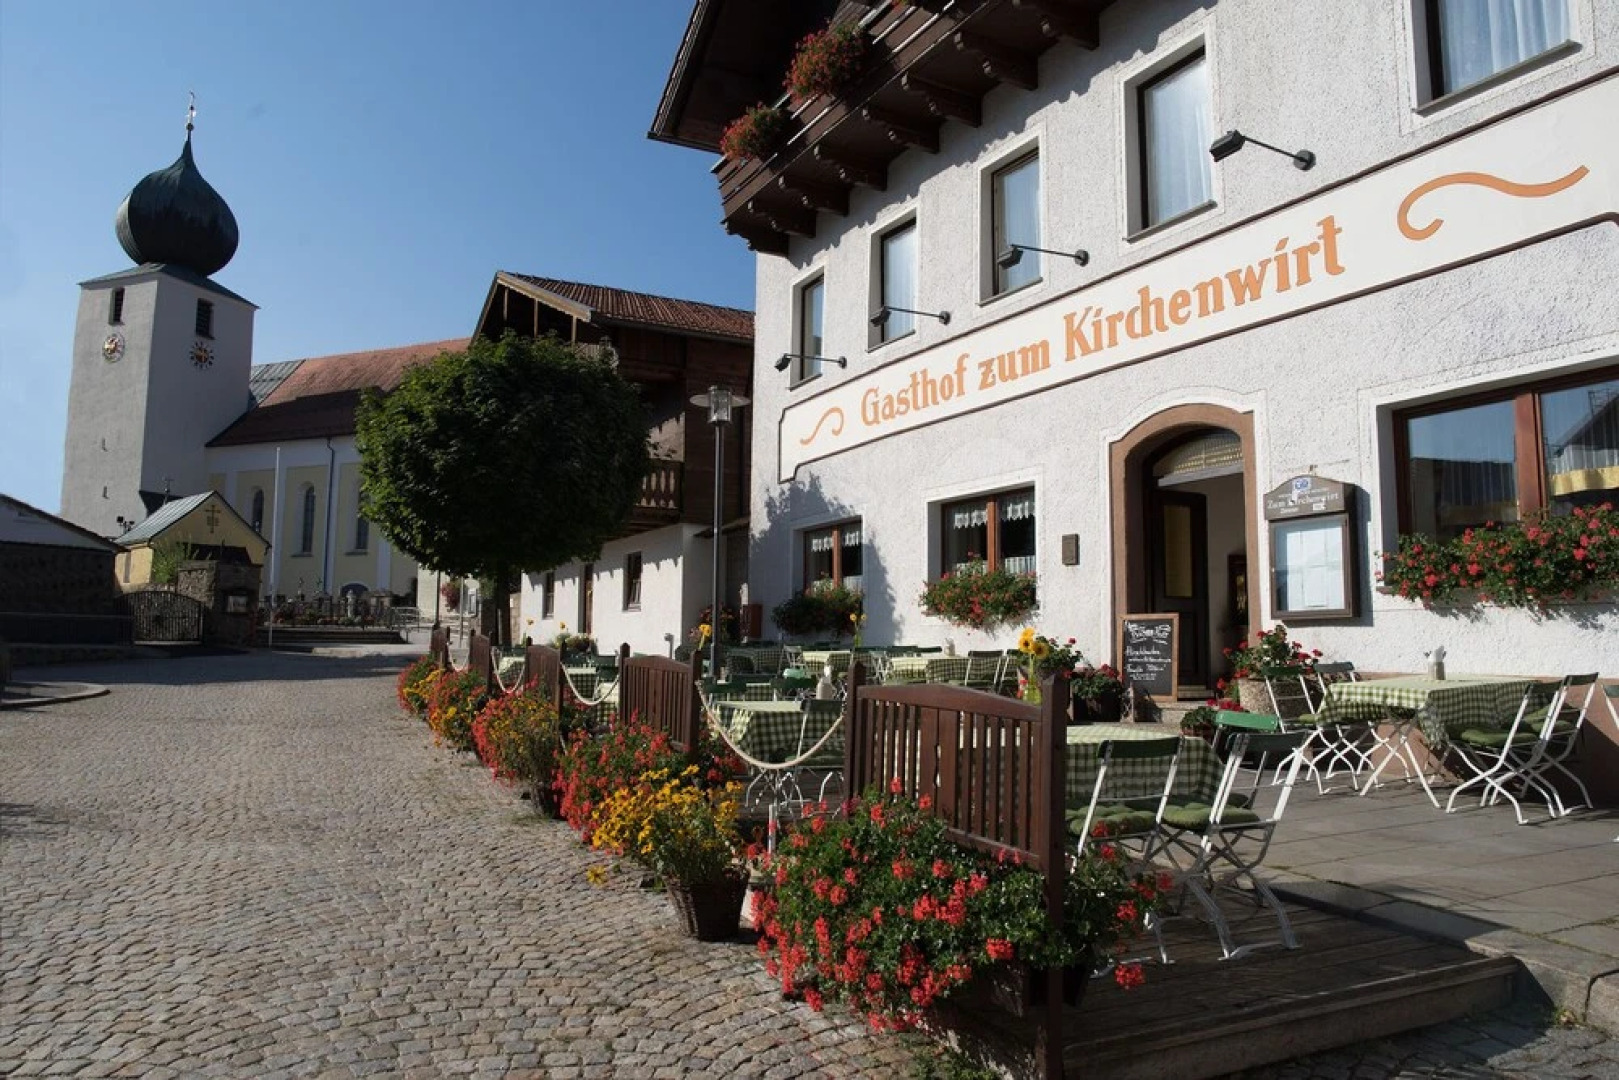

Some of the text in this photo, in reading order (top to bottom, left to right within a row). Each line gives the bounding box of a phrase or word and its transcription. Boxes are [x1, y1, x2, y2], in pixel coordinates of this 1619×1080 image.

[861, 215, 1346, 426] Gasthof zum Kirchenwirt
